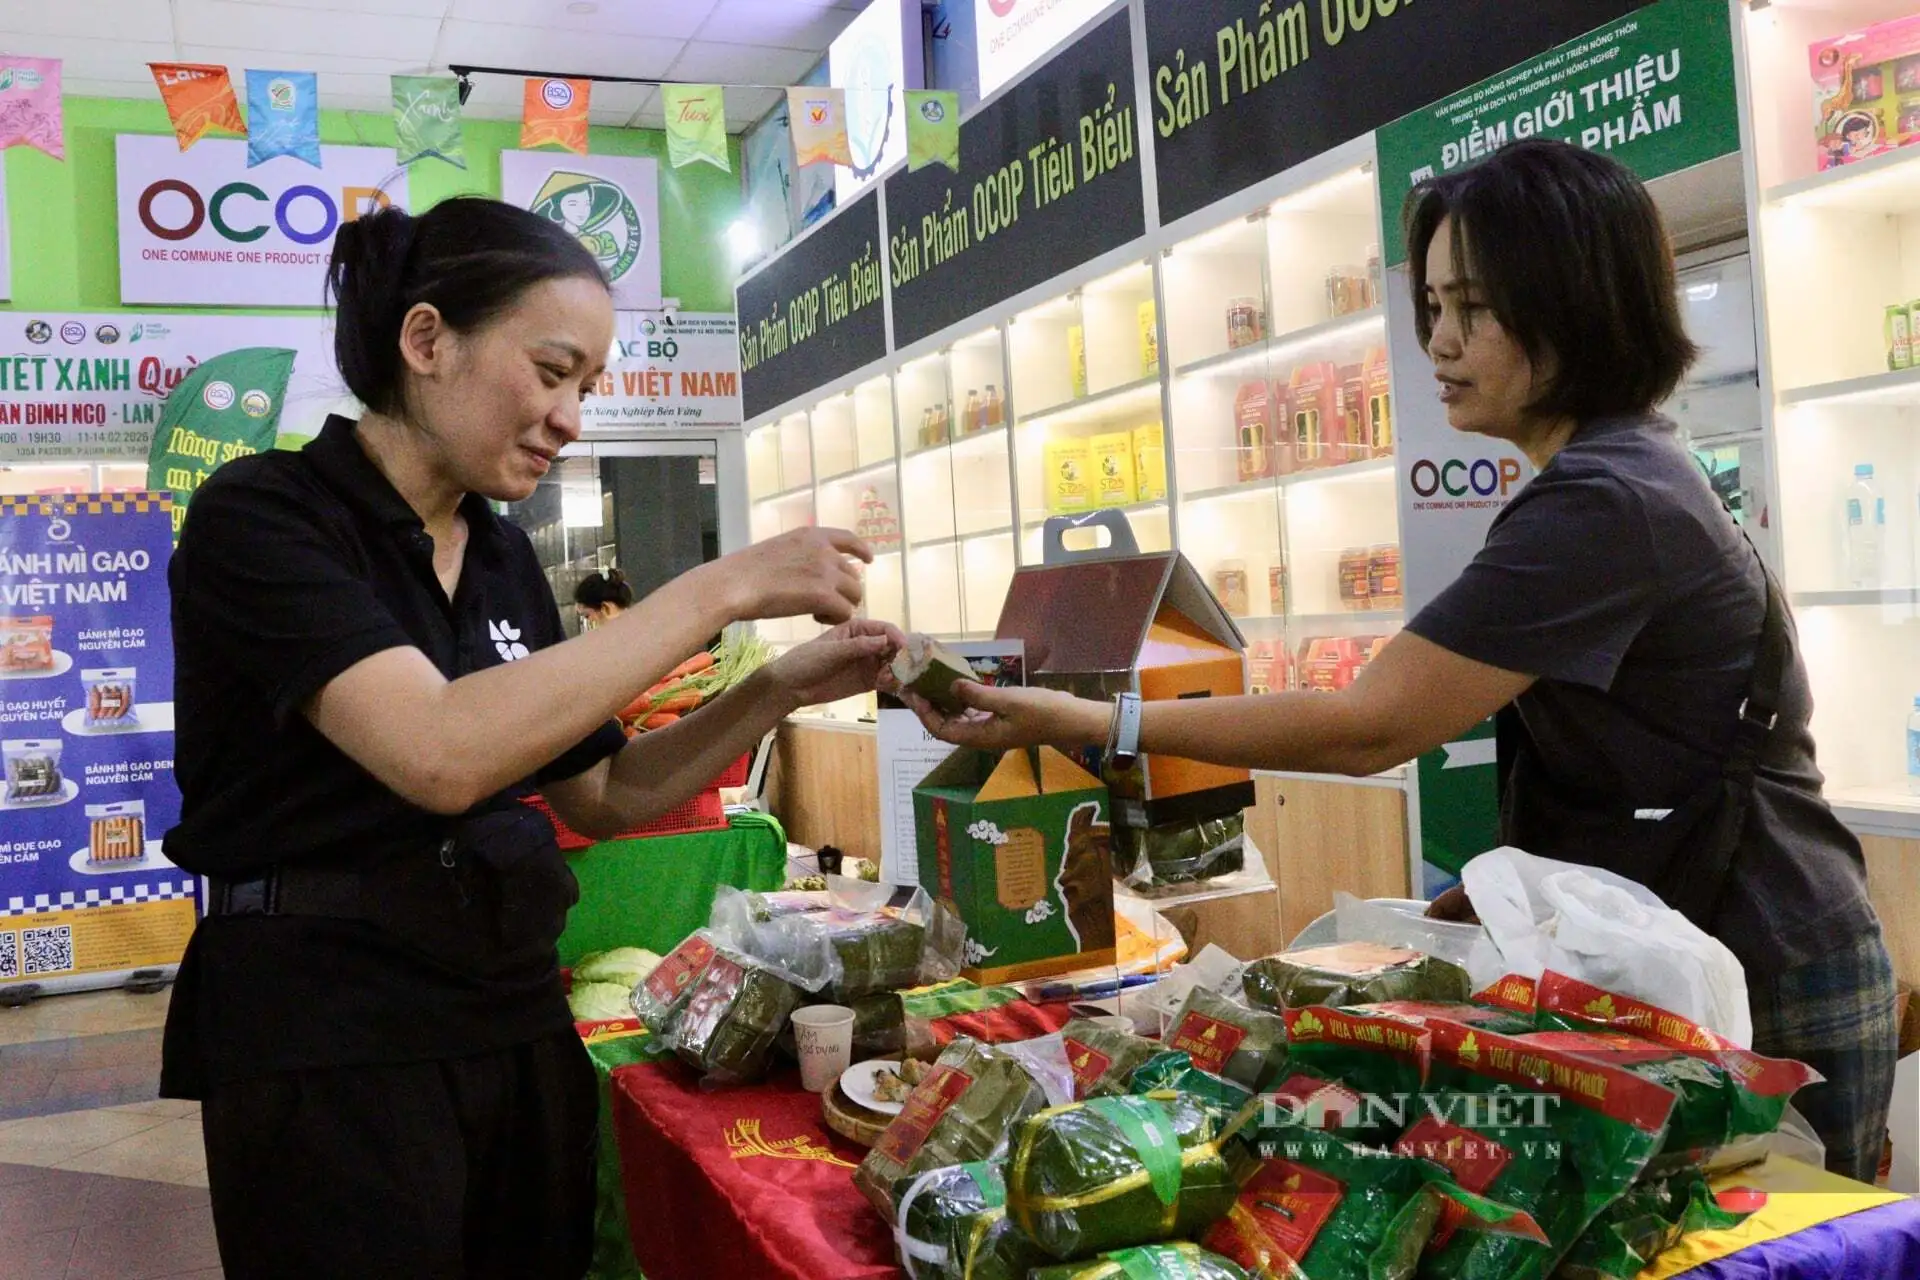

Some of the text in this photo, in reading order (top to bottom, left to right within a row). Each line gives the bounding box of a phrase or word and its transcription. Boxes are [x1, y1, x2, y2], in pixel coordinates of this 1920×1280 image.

[1589, 33, 1613, 50] NÔNG
[1614, 22, 1638, 38] THÔN
[1156, 49, 1209, 138] Sản
[1217, 0, 1309, 105] Phẩm
[1441, 49, 1681, 170] ĐIỂM GIỚI THIỆU
[1582, 94, 1682, 150] PHẨM
[891, 83, 1133, 289] Sản Phẩm OCOP Tiêu Biểu
[142, 249, 167, 261] ONE
[171, 249, 233, 263] COMMUNE
[236, 251, 262, 263] ONE
[265, 252, 321, 265] PRODUCT
[740, 241, 882, 372] Sản Phẩm OCOP Tiêu Biểu
[648, 337, 678, 362] BỘ
[55, 358, 130, 391] XANH
[622, 366, 673, 402] VIỆT
[681, 371, 737, 397] NAM
[72, 403, 106, 427] NGỌ
[123, 403, 154, 424] LAN
[28, 431, 61, 444] 19H30
[167, 426, 221, 466] Nông
[1410, 458, 1521, 498] OCOP
[56, 544, 87, 574] MÌ
[92, 549, 150, 579] GẠO
[2, 577, 127, 612] VIỆT NAM
[78, 628, 106, 640] BÁNH
[107, 627, 120, 639] MÌ
[79, 639, 121, 651] NGUYÊN
[85, 764, 114, 775] BÁNH
[115, 762, 128, 773] MÌ
[153, 760, 174, 770] ĐEN
[86, 774, 129, 786] NGUYÊN
[13, 841, 36, 852] QUE
